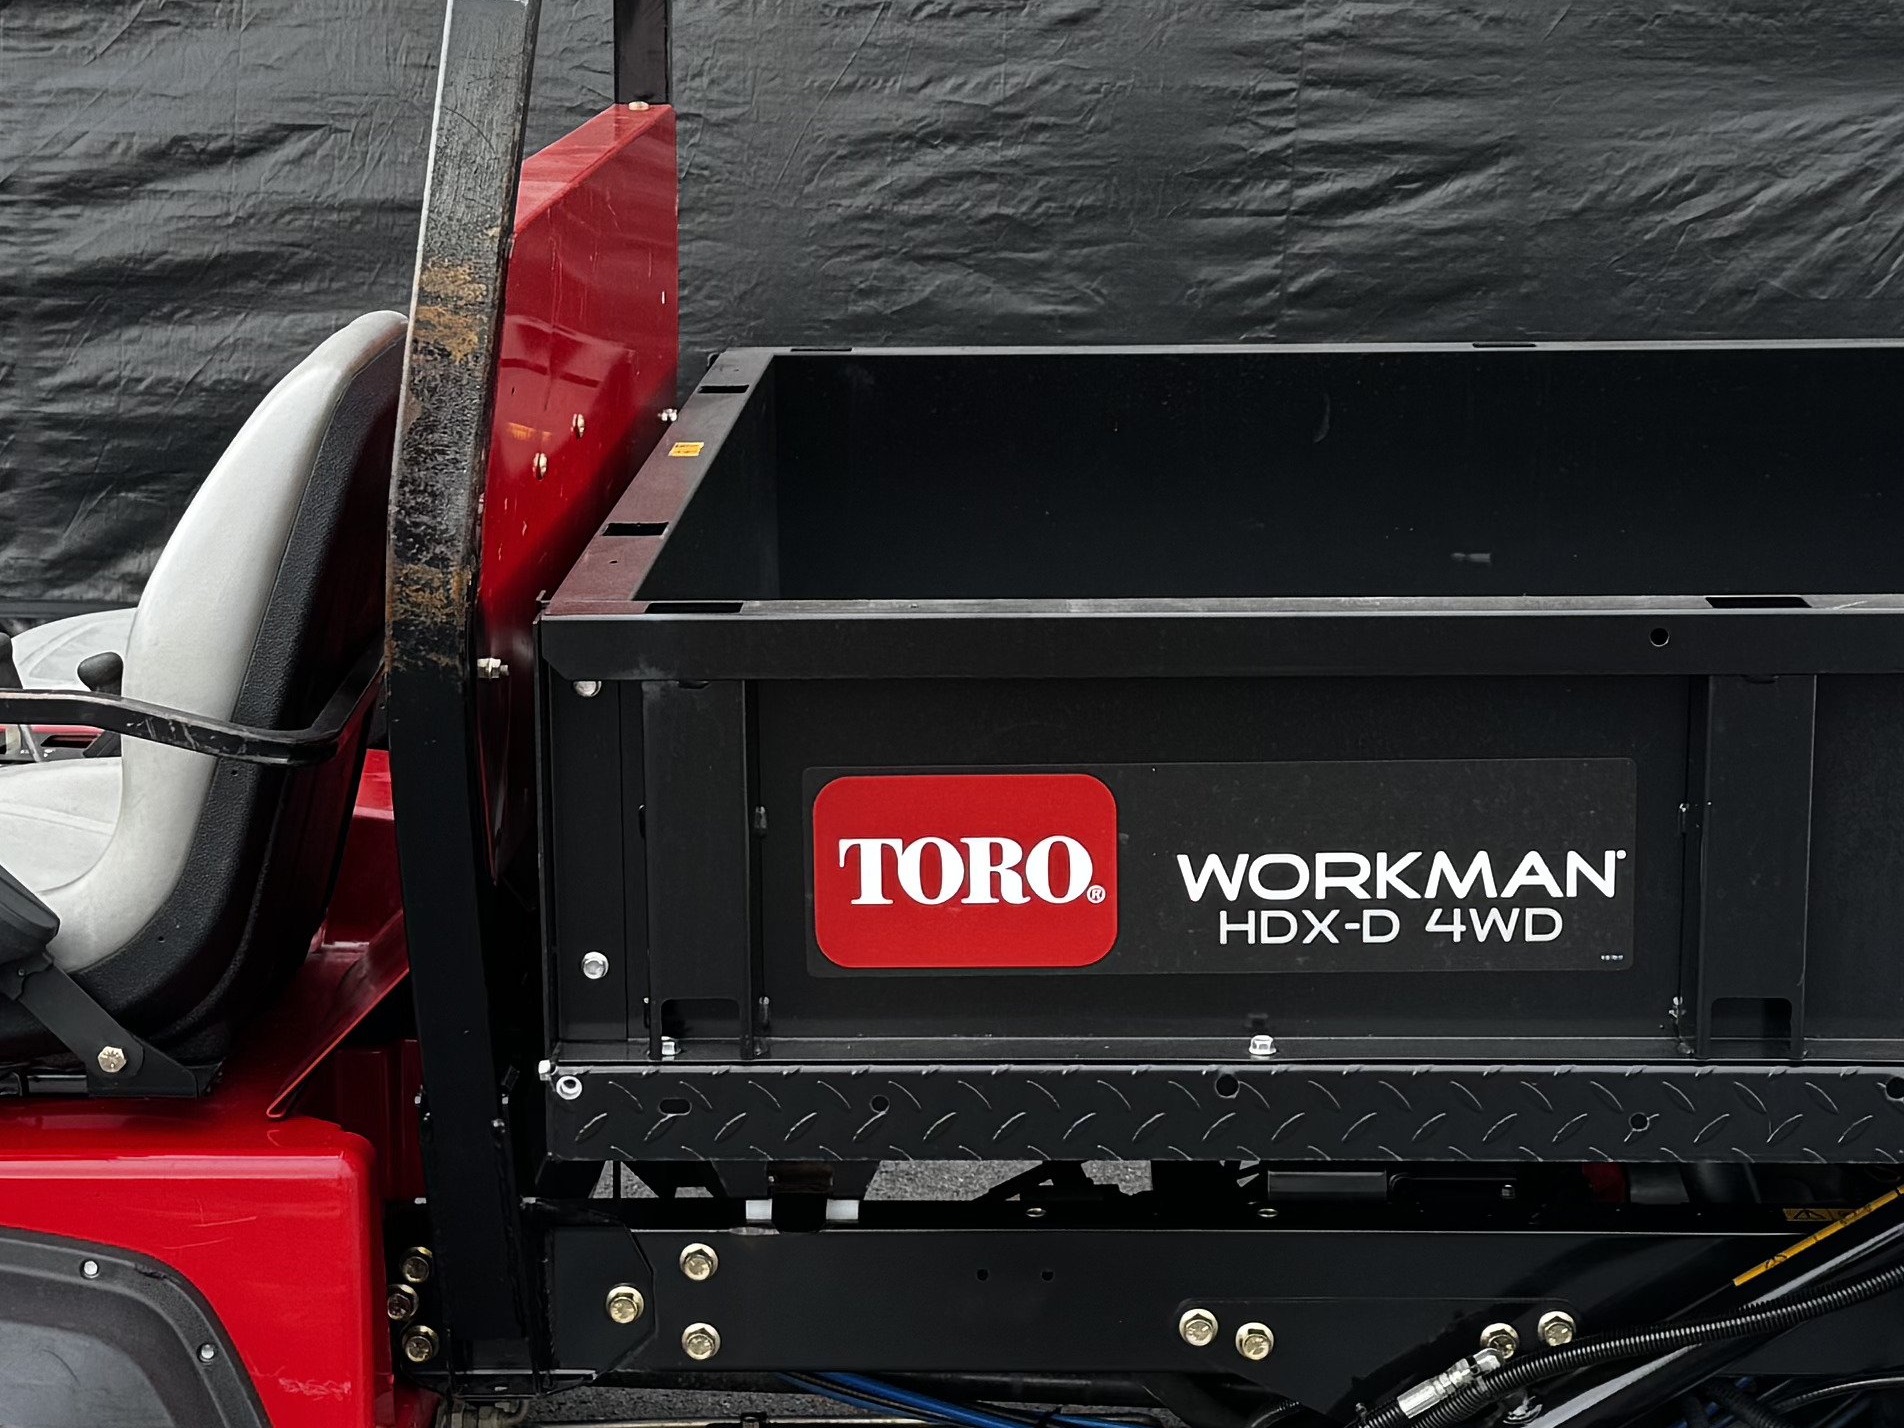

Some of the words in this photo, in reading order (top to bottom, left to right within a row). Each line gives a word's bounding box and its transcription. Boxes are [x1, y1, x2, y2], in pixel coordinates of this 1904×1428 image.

[838, 835, 1093, 906] TORO
[1177, 849, 1615, 902] WORKMAN
[1219, 909, 1400, 945] HDX-D
[1425, 907, 1563, 943] 4WD
